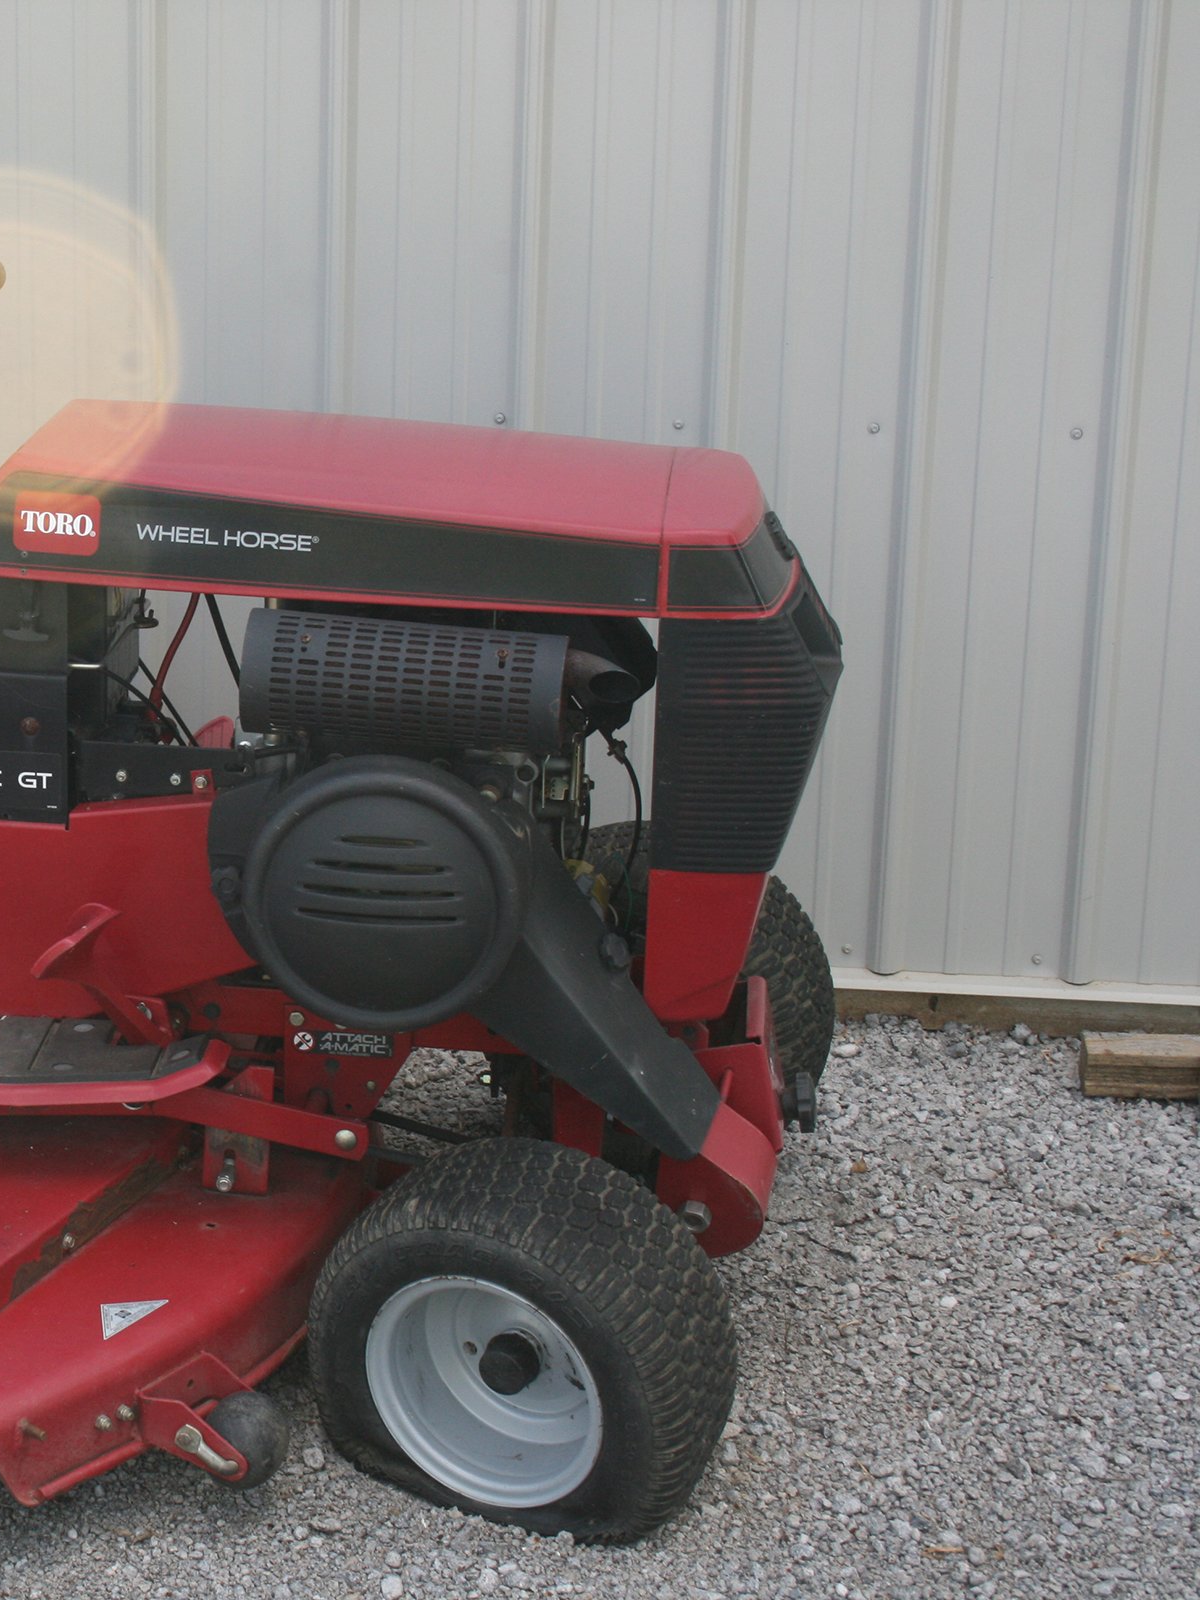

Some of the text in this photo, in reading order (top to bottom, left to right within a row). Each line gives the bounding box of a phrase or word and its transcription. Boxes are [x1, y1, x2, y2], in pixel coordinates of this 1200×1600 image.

[21, 510, 93, 537] TORO
[136, 523, 219, 545] WHEEL
[17, 771, 53, 789] GT
[321, 1032, 387, 1045] ATTACH
